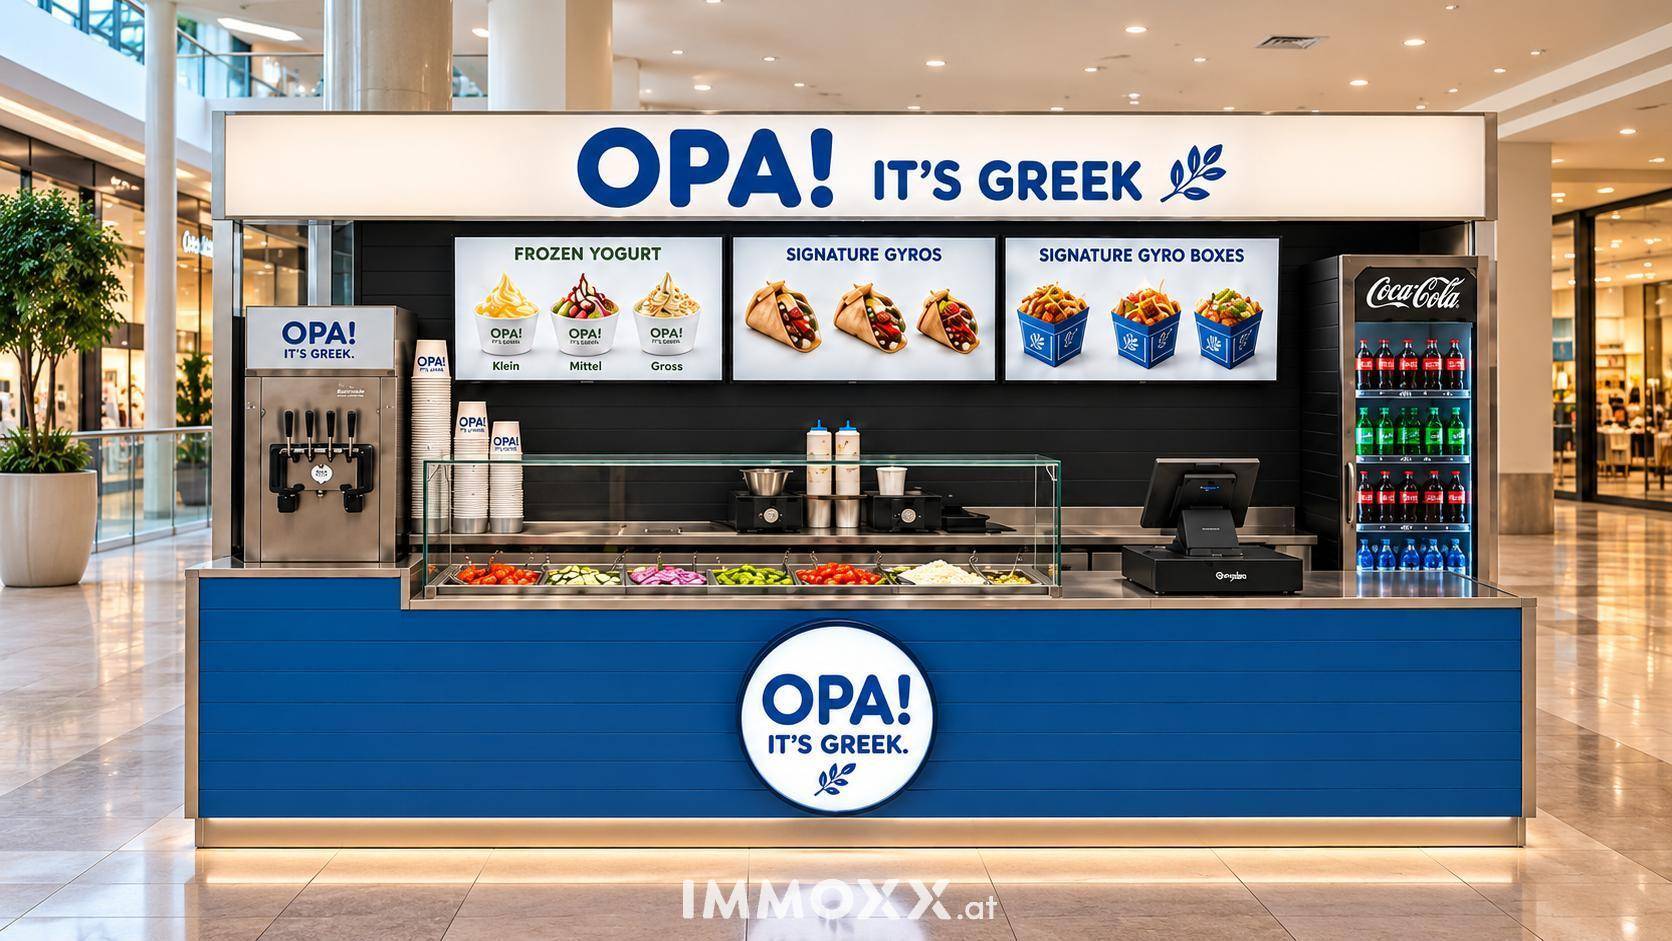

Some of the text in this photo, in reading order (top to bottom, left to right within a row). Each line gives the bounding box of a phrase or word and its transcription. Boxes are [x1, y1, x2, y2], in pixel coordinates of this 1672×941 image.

[577, 127, 1143, 209] OPA! IT'S GREEK
[514, 247, 662, 261] FROZEN YOGURT
[786, 247, 942, 262] SIGNATURE GYROS
[1039, 248, 1245, 263] SIGNATURE GYRO BOXES
[1366, 276, 1466, 309] Coca-Cola
[281, 321, 356, 345] OPA!
[490, 328, 522, 338] OPA!
[568, 328, 601, 339] OPA!
[650, 328, 682, 338] OPA!
[284, 348, 355, 359] IT'S GREEK.
[417, 356, 446, 367] OPA!
[492, 361, 520, 371] Klein
[569, 361, 602, 371] Mittel
[651, 361, 683, 371] Gross
[459, 417, 486, 428] OPA!
[493, 437, 519, 446] OPA!
[762, 673, 911, 726] OPA!
[768, 734, 909, 755] IT'S GREEK.
